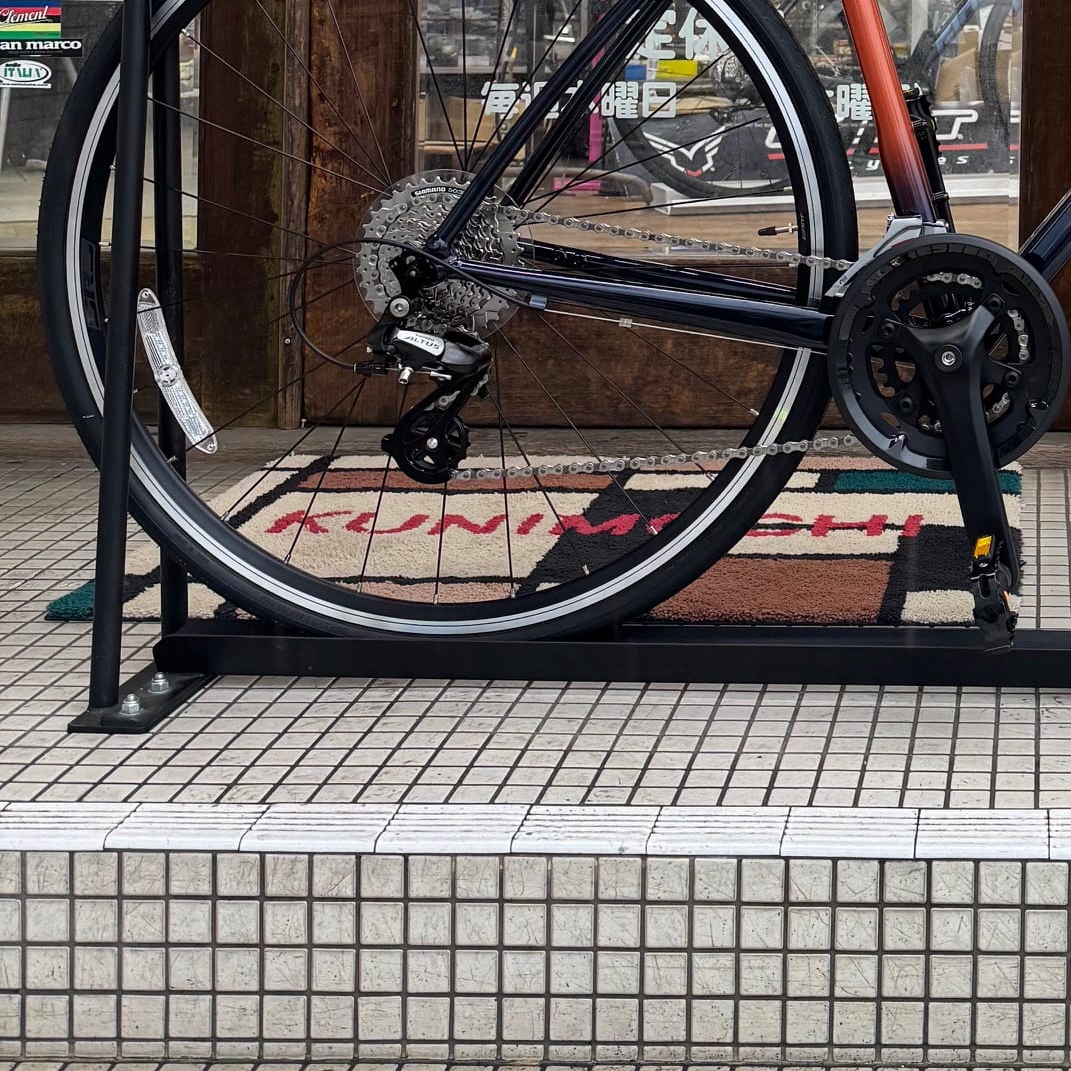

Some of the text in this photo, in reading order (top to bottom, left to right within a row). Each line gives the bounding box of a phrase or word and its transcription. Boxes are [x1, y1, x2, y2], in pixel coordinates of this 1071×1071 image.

[0, 40, 82, 50] an marco
[4, 67, 41, 78] ITALIA
[403, 336, 440, 350] ALTUS
[266, 511, 924, 538] KUNIMCHI
